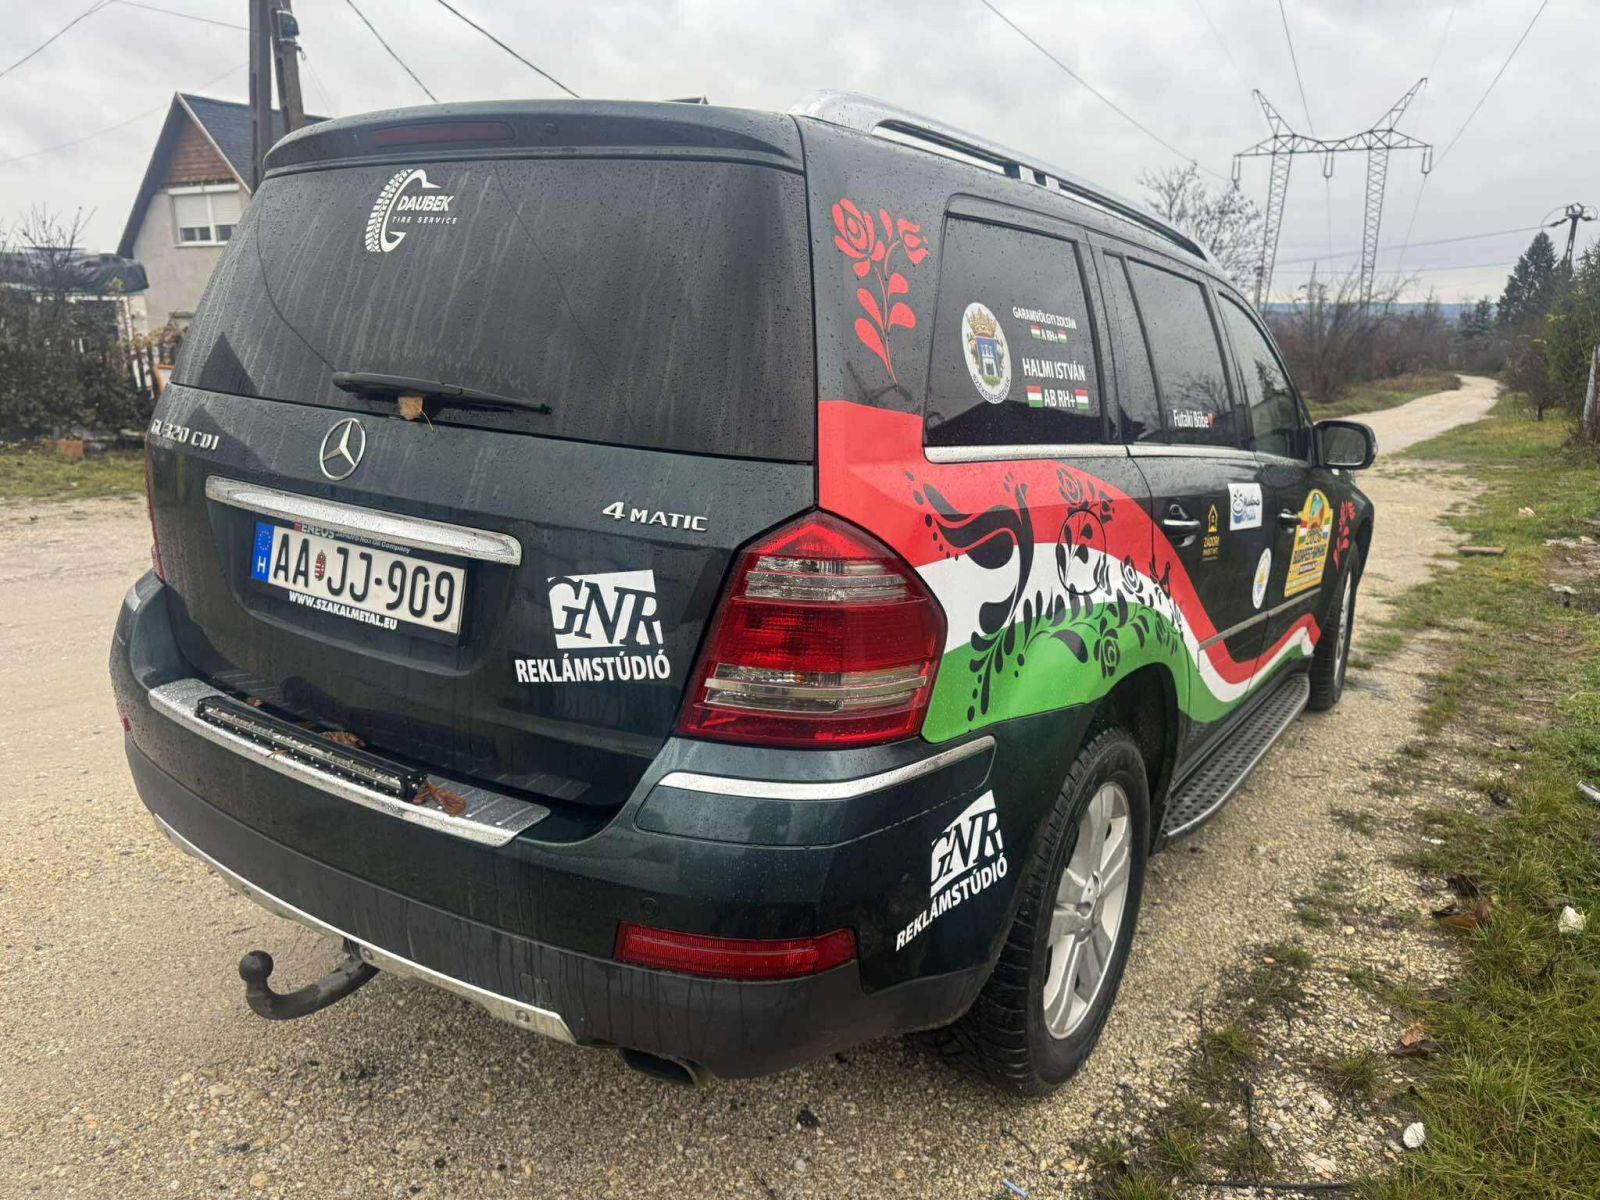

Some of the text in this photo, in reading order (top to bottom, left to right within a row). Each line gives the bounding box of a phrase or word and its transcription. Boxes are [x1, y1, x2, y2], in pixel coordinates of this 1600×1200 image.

[396, 195, 454, 211] DAUBEK
[392, 216, 458, 225] TIRE SERVICE
[1022, 358, 1086, 382] HALMI ISTVÁN
[1044, 388, 1076, 408] AB RH+
[190, 432, 220, 451] CDI
[257, 556, 266, 574] H
[273, 533, 455, 622] AA JJ-909
[288, 590, 398, 630] WWW.SZAKALMETAL.EU
[514, 649, 671, 683] REKLÁMSTÚDIÓ
[896, 852, 1008, 952] REKLÁMSTÚDIÓ
